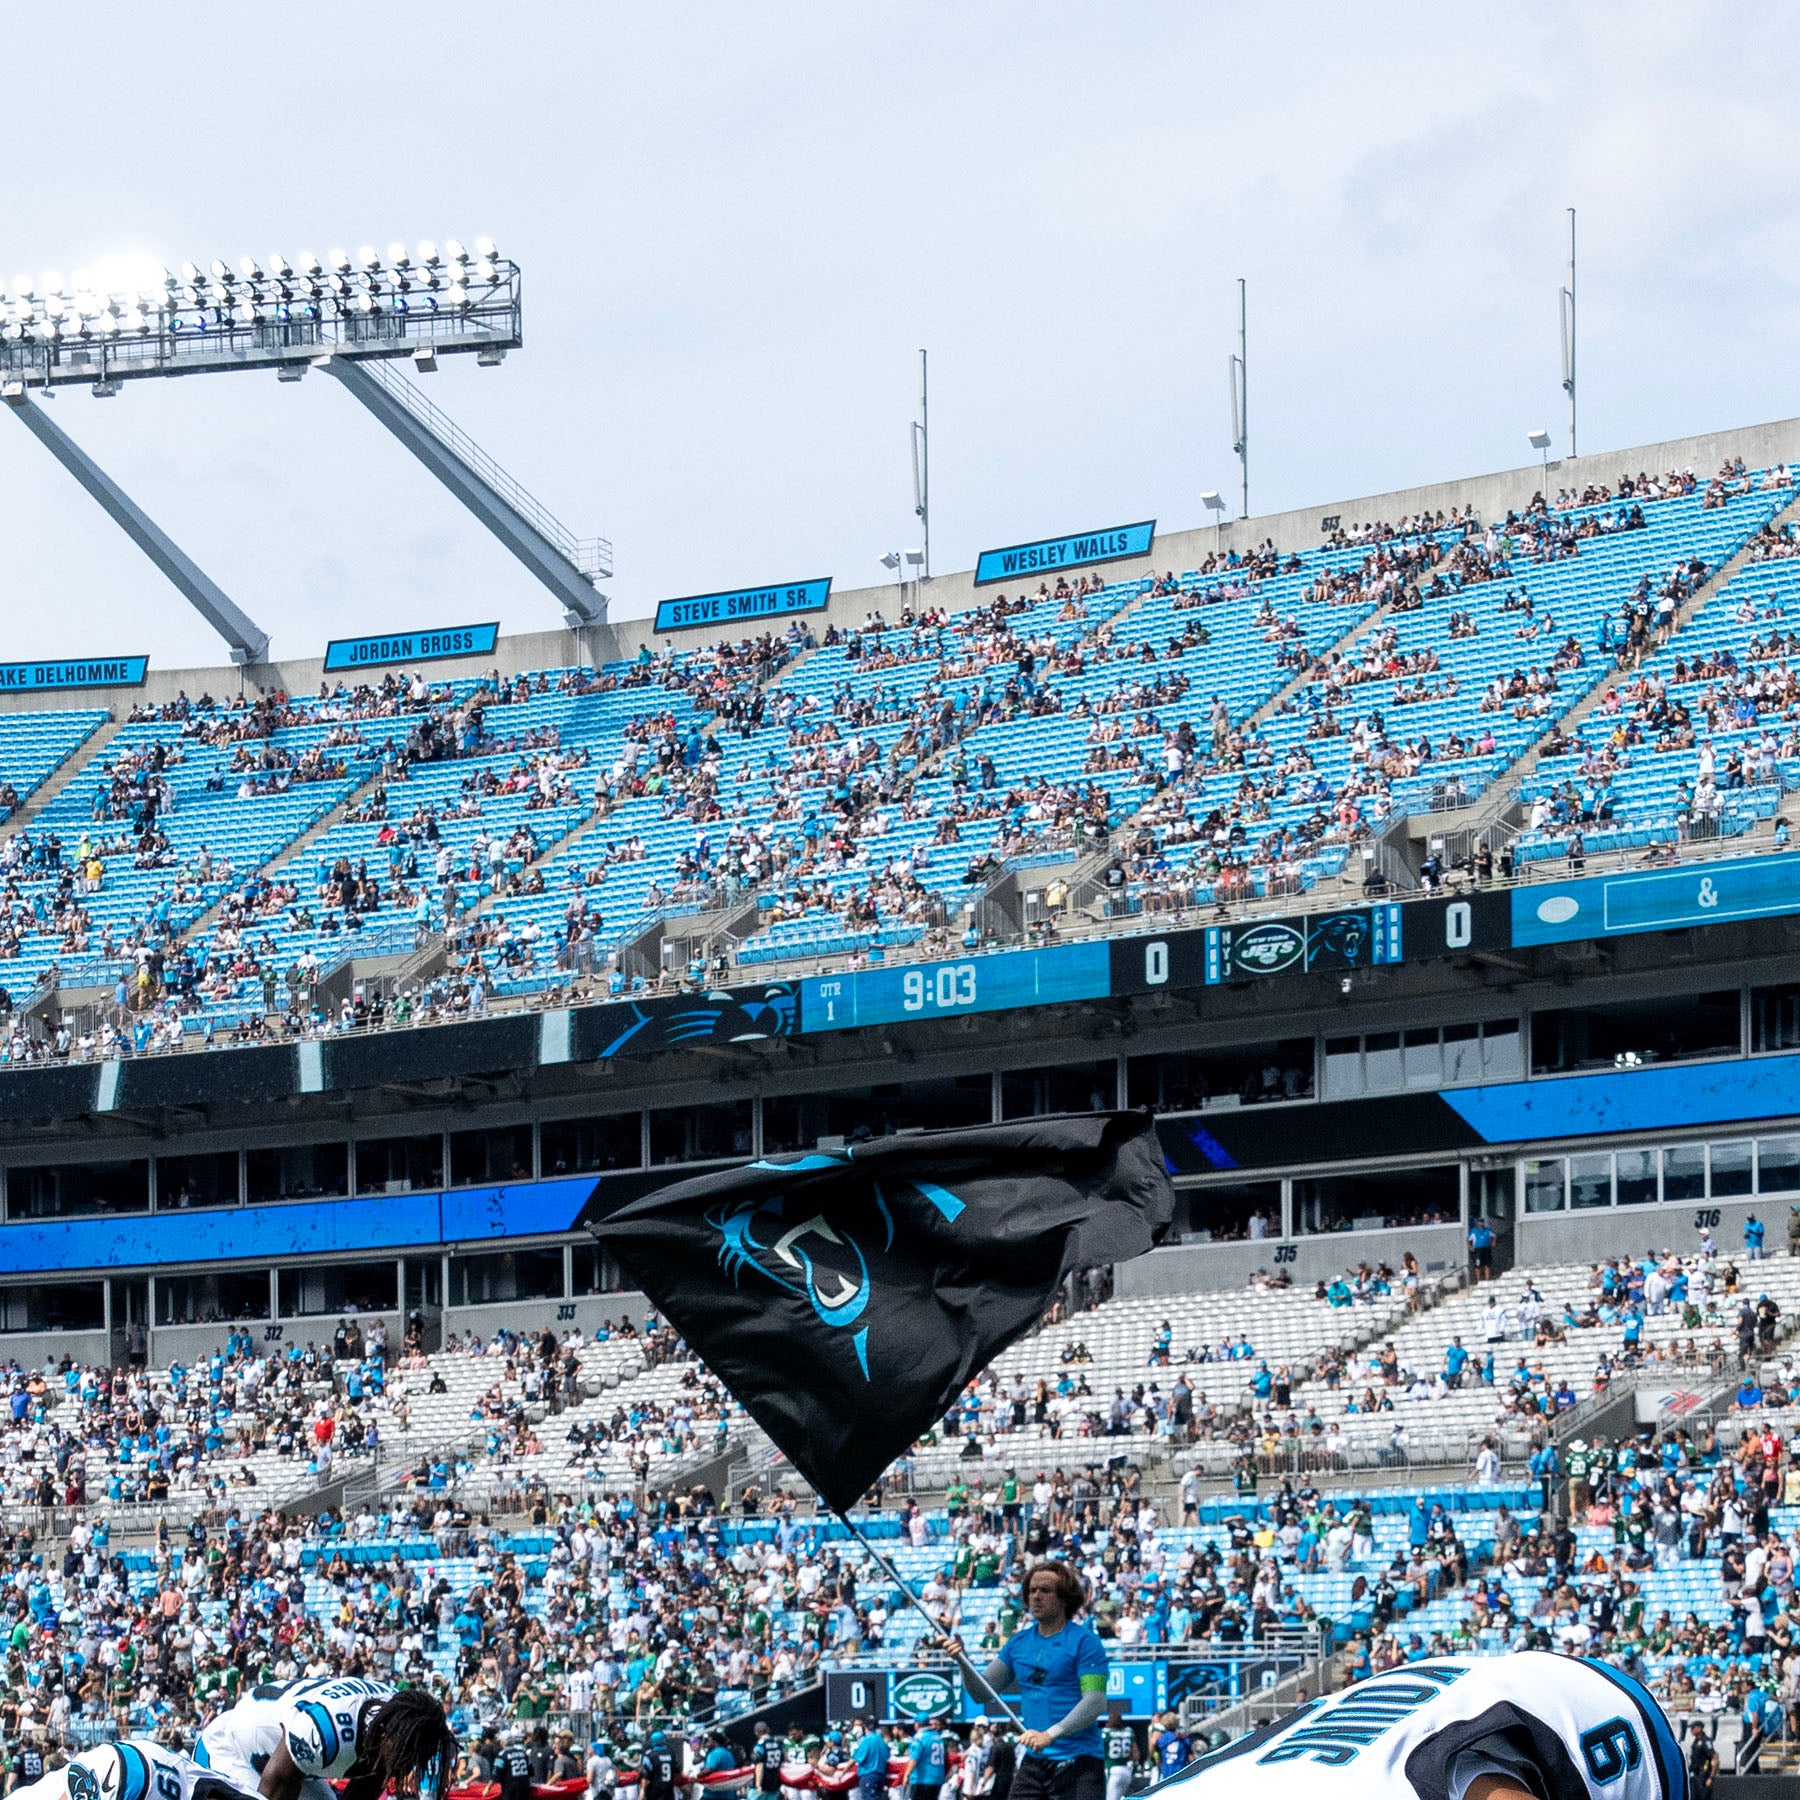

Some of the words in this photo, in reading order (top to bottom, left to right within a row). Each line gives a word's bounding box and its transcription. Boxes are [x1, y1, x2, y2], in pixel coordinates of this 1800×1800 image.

[1321, 515, 1341, 533] 513
[1002, 547, 1066, 572] WESLEY
[1072, 534, 1128, 559] WALLS
[672, 600, 719, 622] STEVE
[727, 594, 778, 616] SMITH
[787, 588, 812, 607] SR.
[349, 638, 413, 661] JORDAN
[420, 632, 473, 654] GROSS
[35, 662, 128, 685] DELHOMME
[1698, 877, 1718, 907] &
[1376, 912, 1384, 958] CAR
[1446, 902, 1471, 948] 0
[1222, 930, 1231, 977] NYJ
[1241, 940, 1296, 959] JETS
[1145, 942, 1168, 985] 0
[903, 963, 976, 1009] 9:03
[827, 1001, 834, 1021] 1
[1694, 1210, 1720, 1229] 316
[1274, 1244, 1298, 1264] 315
[557, 1304, 577, 1320] 313
[264, 1325, 283, 1341] 312
[851, 1681, 865, 1708] 0
[899, 1690, 948, 1704] JETS
[335, 1712, 355, 1742] 80
[1256, 1665, 1471, 1766] YOUNG
[25, 1759, 40, 1774] 59
[510, 1759, 528, 1775] 22
[661, 1763, 670, 1780] 9
